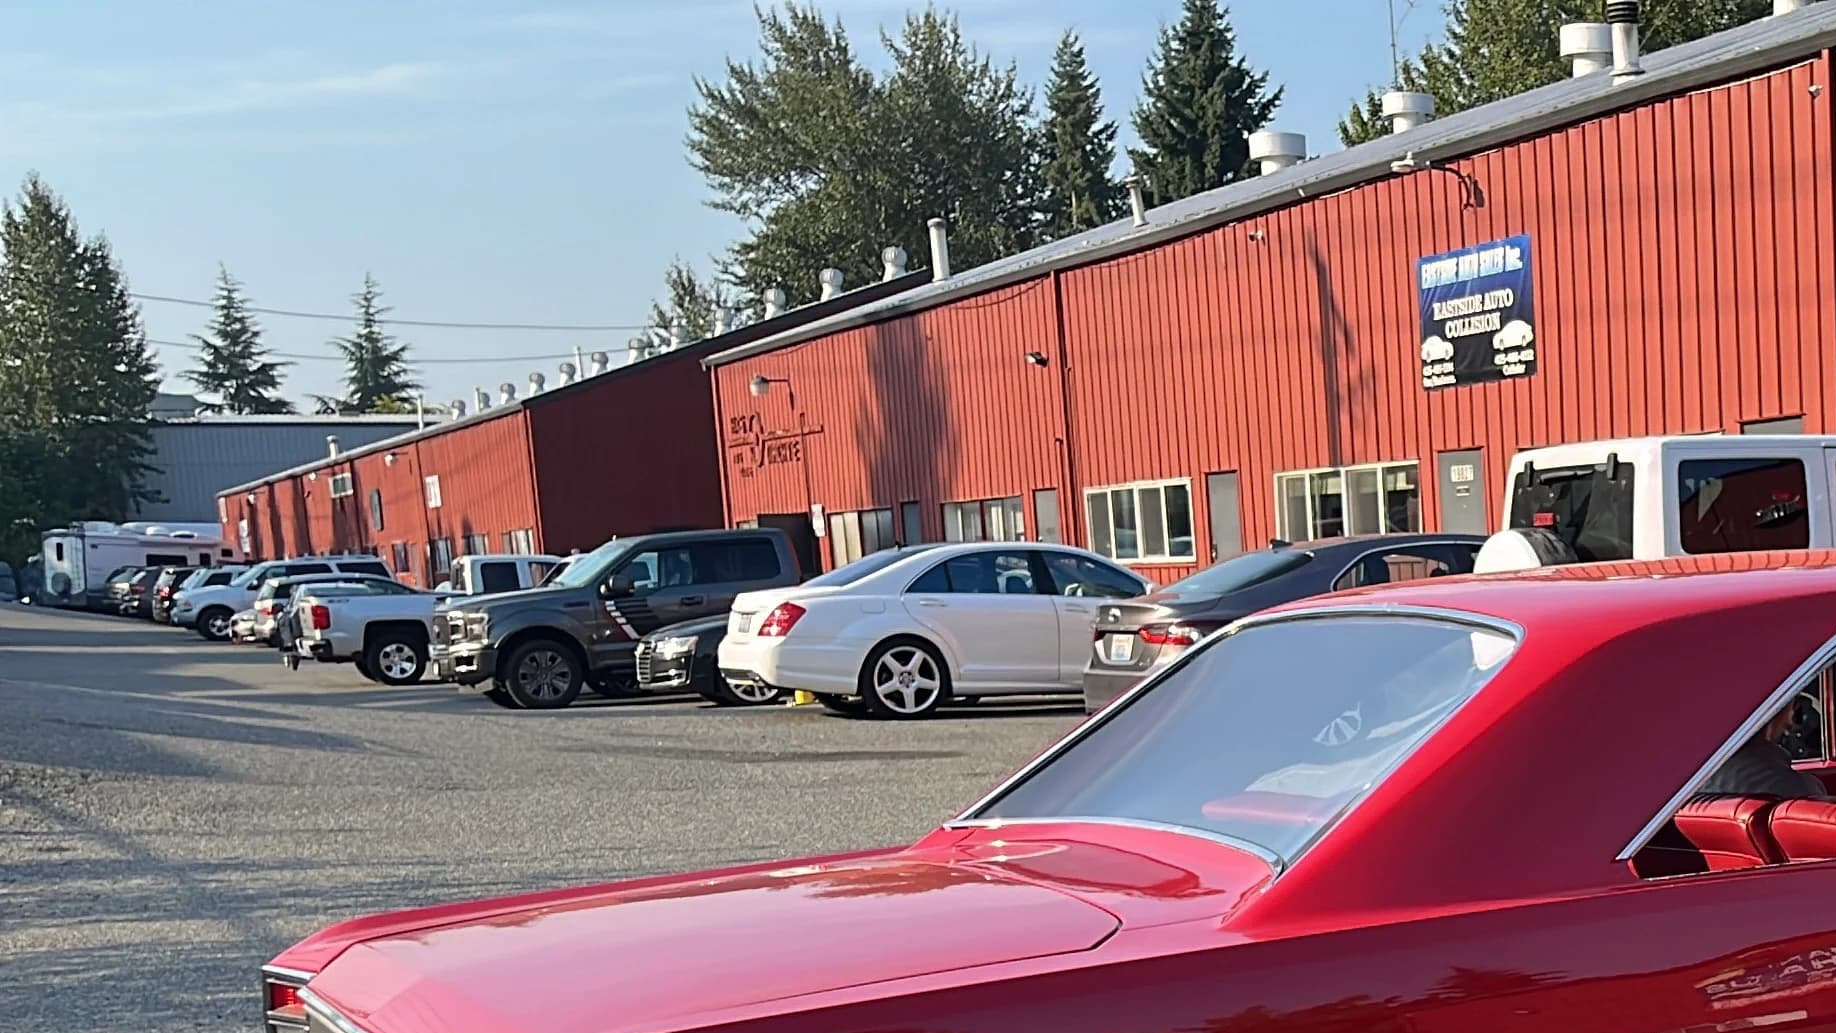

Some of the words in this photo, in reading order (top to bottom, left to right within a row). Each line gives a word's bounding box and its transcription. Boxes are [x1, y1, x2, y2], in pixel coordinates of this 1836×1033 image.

[1432, 294, 1483, 321] EASTSIDE
[1484, 288, 1514, 312] AUTO
[1445, 312, 1501, 338] COLLISION
